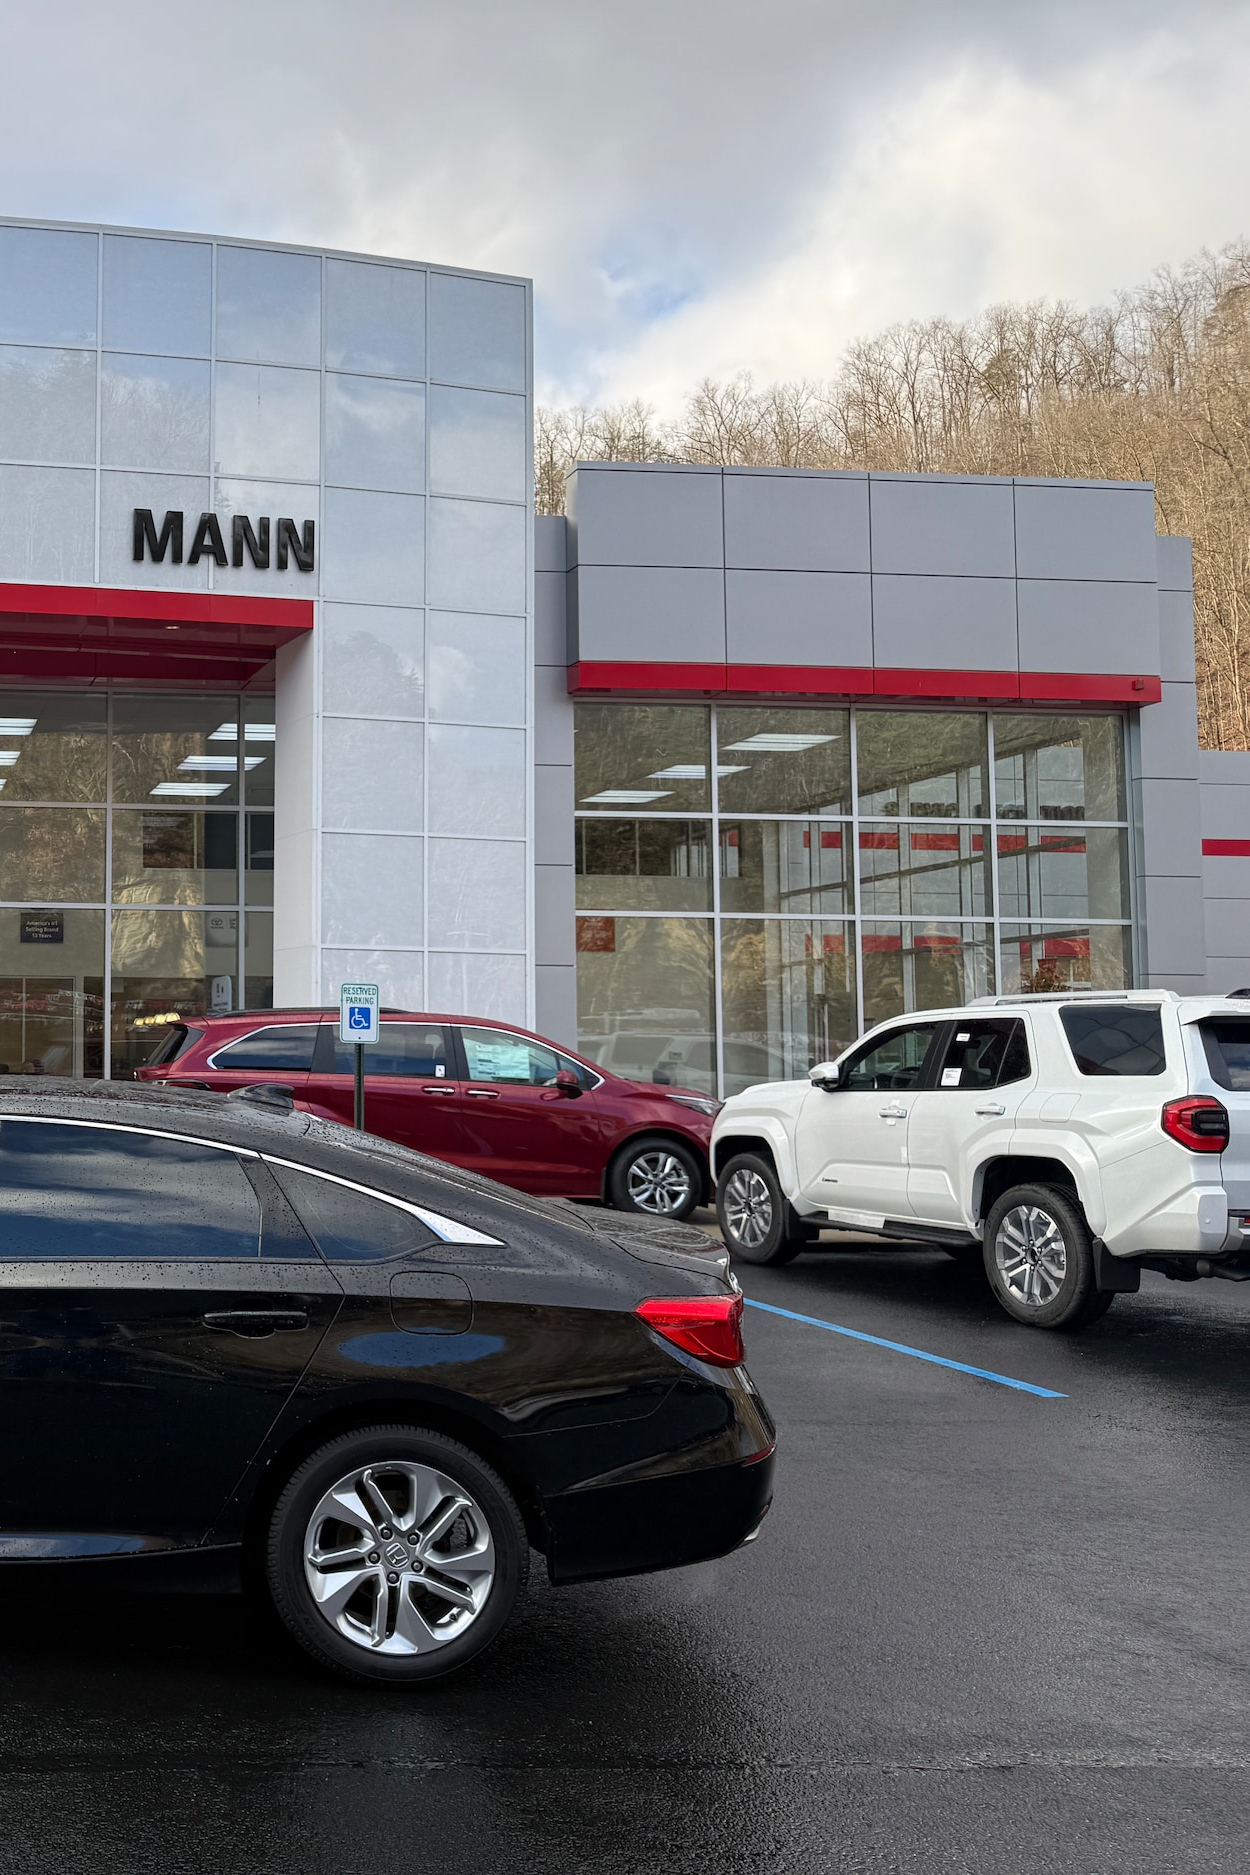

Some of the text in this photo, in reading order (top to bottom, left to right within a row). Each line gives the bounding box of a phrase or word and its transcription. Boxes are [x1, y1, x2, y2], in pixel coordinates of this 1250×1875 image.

[132, 508, 315, 572] MANN
[343, 986, 376, 996] RESERVED
[346, 997, 374, 1005] PARKING
